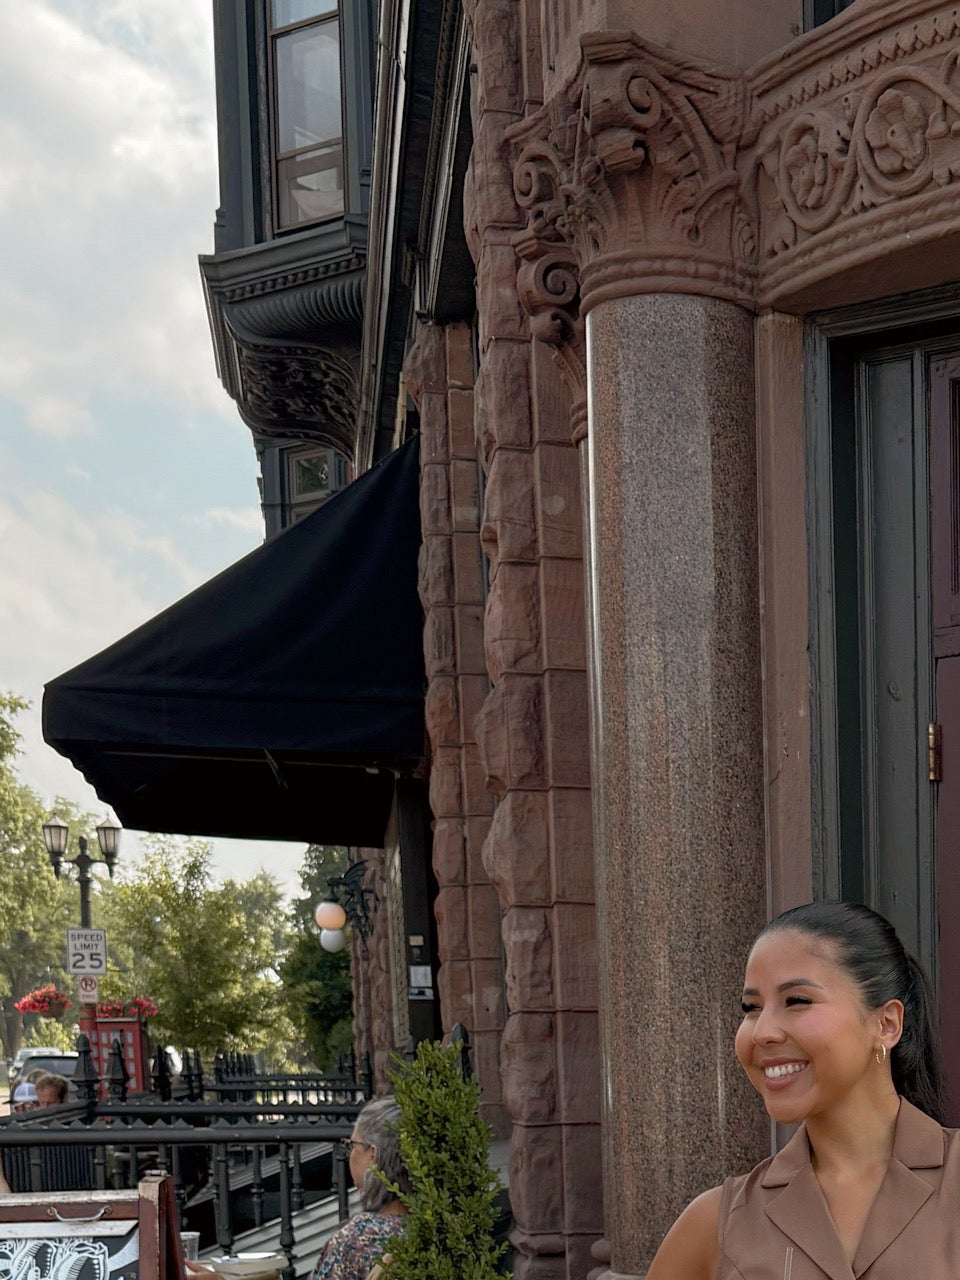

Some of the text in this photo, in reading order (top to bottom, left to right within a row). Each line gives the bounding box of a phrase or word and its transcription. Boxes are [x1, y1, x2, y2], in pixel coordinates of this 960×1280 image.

[71, 933, 103, 942] SPEED
[74, 943, 99, 951] LIMIT
[72, 952, 103, 969] 25
